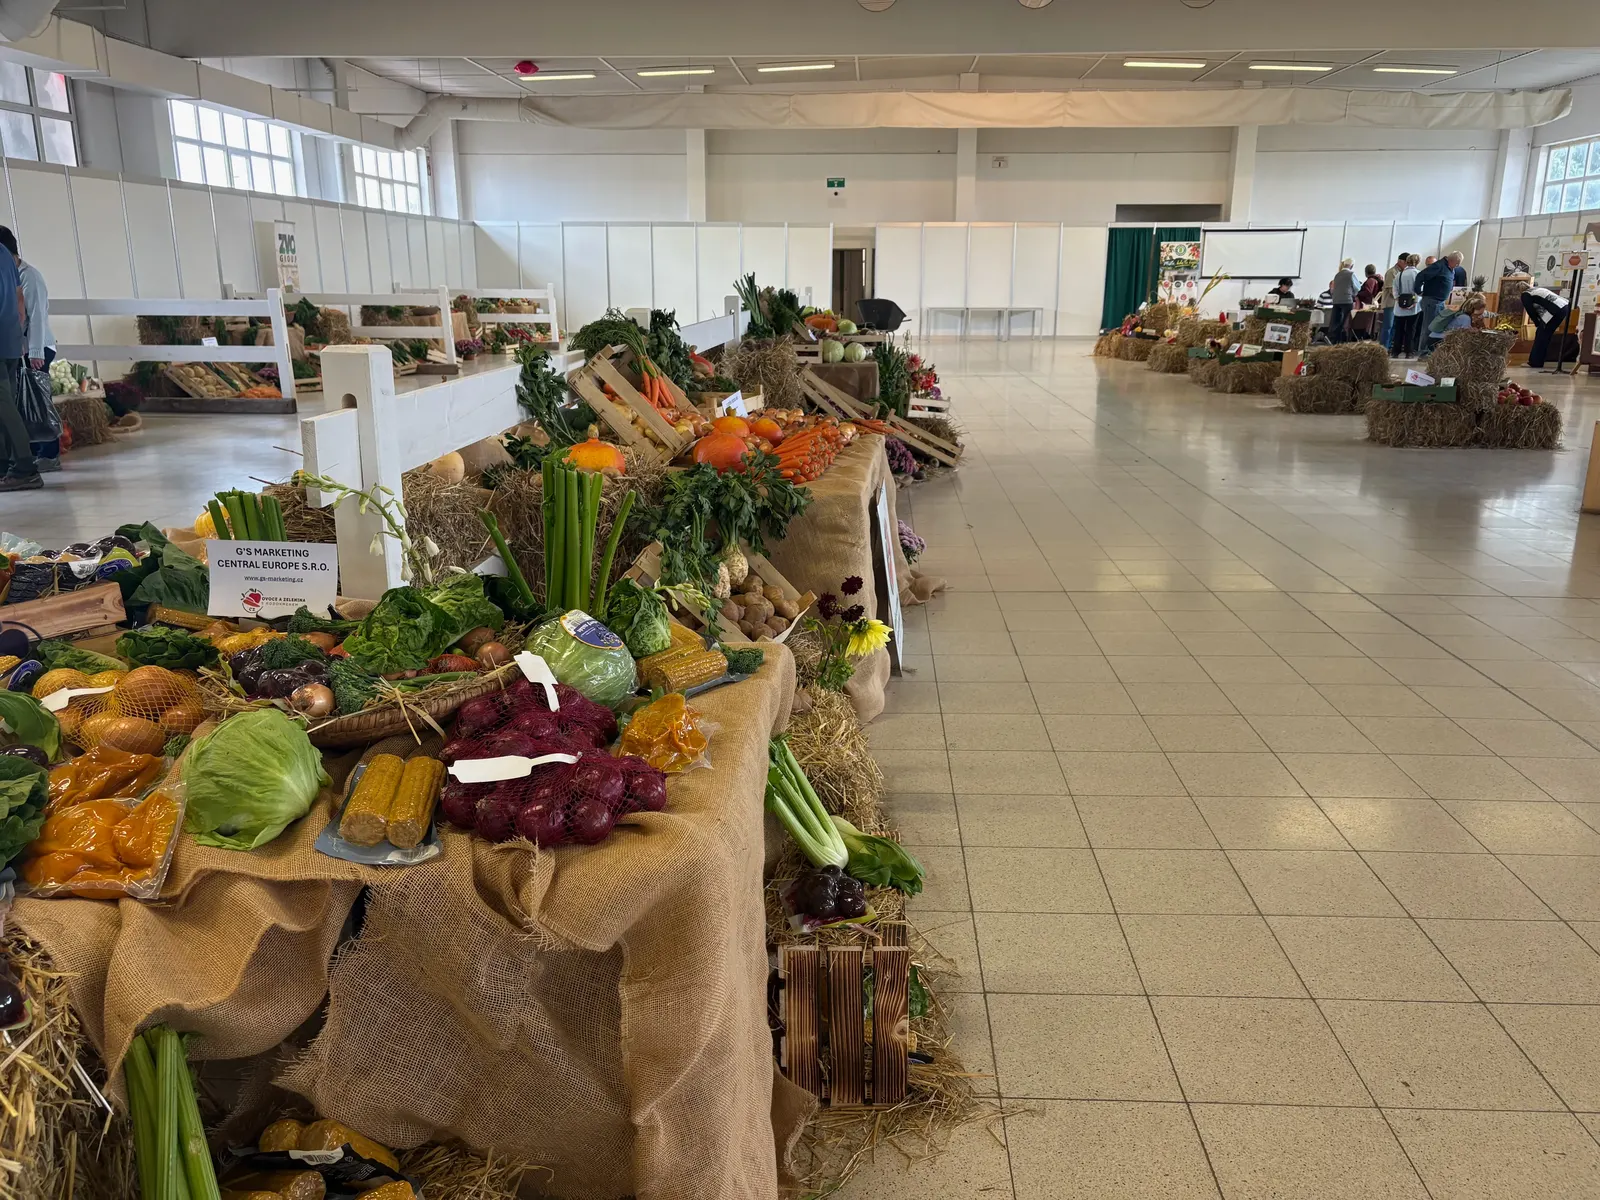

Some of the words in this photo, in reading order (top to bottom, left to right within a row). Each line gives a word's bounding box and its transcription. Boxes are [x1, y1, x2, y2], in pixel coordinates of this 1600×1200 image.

[278, 233, 296, 255] ZVO
[236, 547, 253, 556] G'S
[254, 548, 309, 557] MARKETING
[217, 559, 260, 569] CENTRAL
[262, 561, 299, 570] EUROPE
[302, 562, 330, 571] S.R.O.
[244, 575, 303, 583] www.gs-marketing.cz
